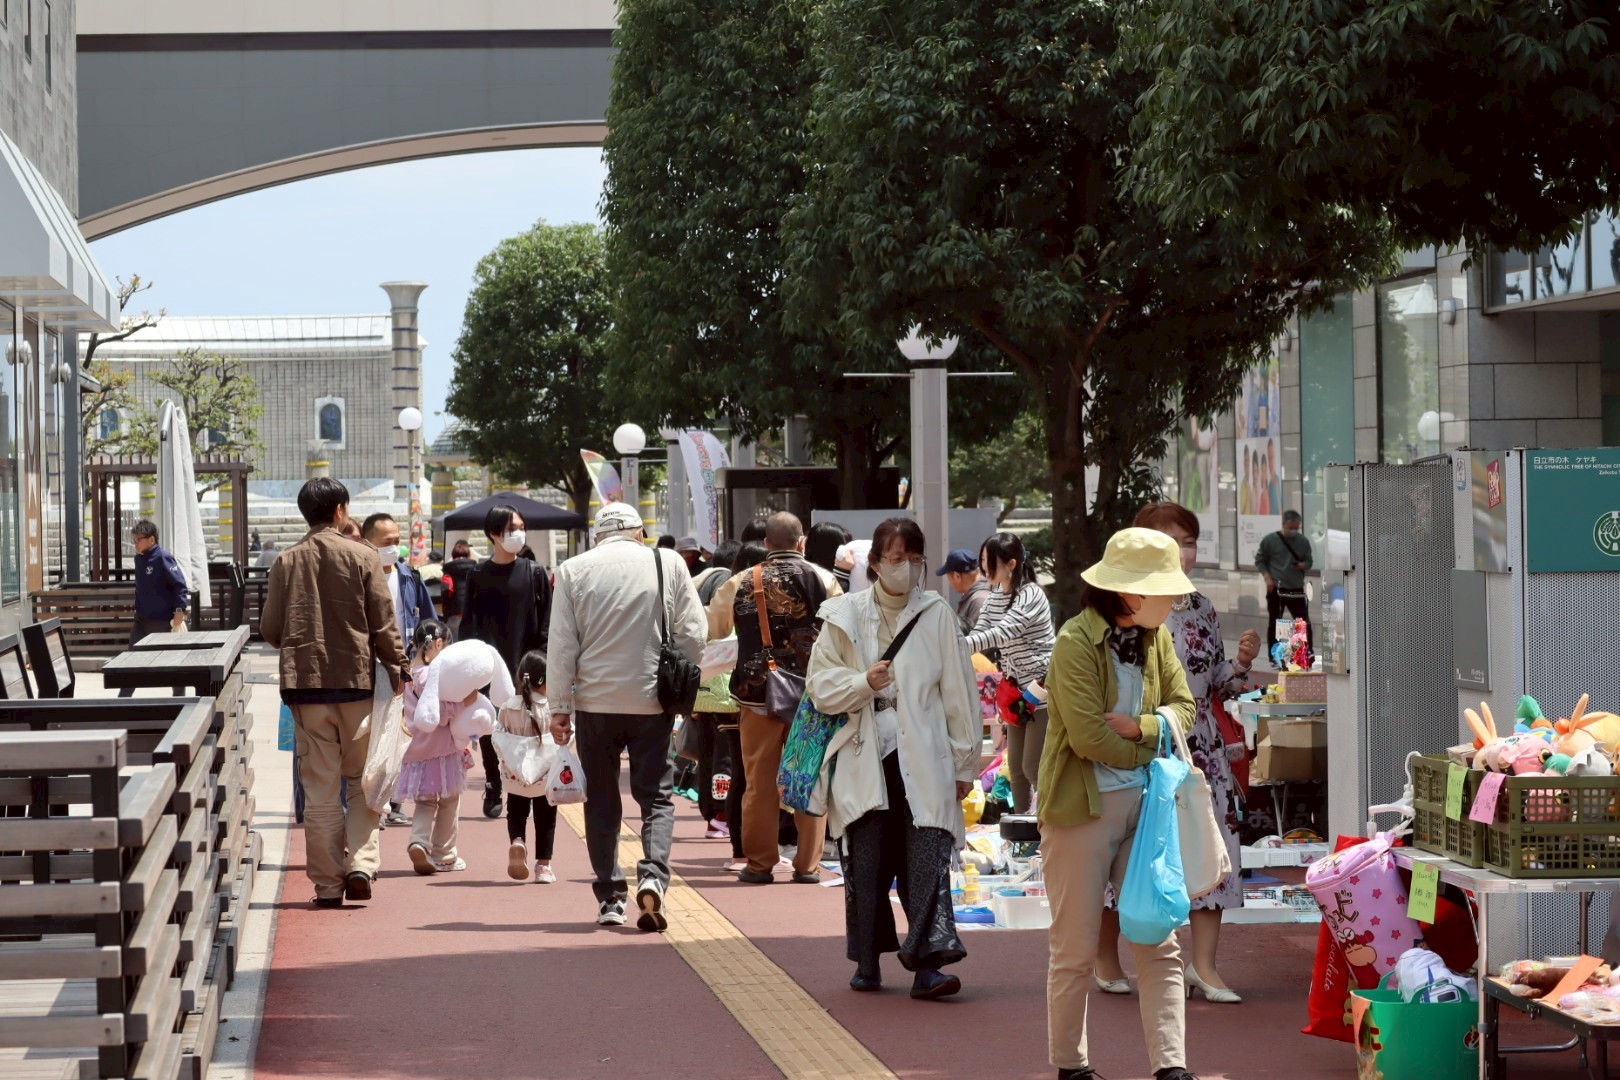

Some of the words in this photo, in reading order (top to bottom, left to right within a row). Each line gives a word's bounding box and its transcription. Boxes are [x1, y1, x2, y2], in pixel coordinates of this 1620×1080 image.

[1533, 456, 1570, 464] 日立市の木
[1575, 456, 1597, 464] ケヤキ
